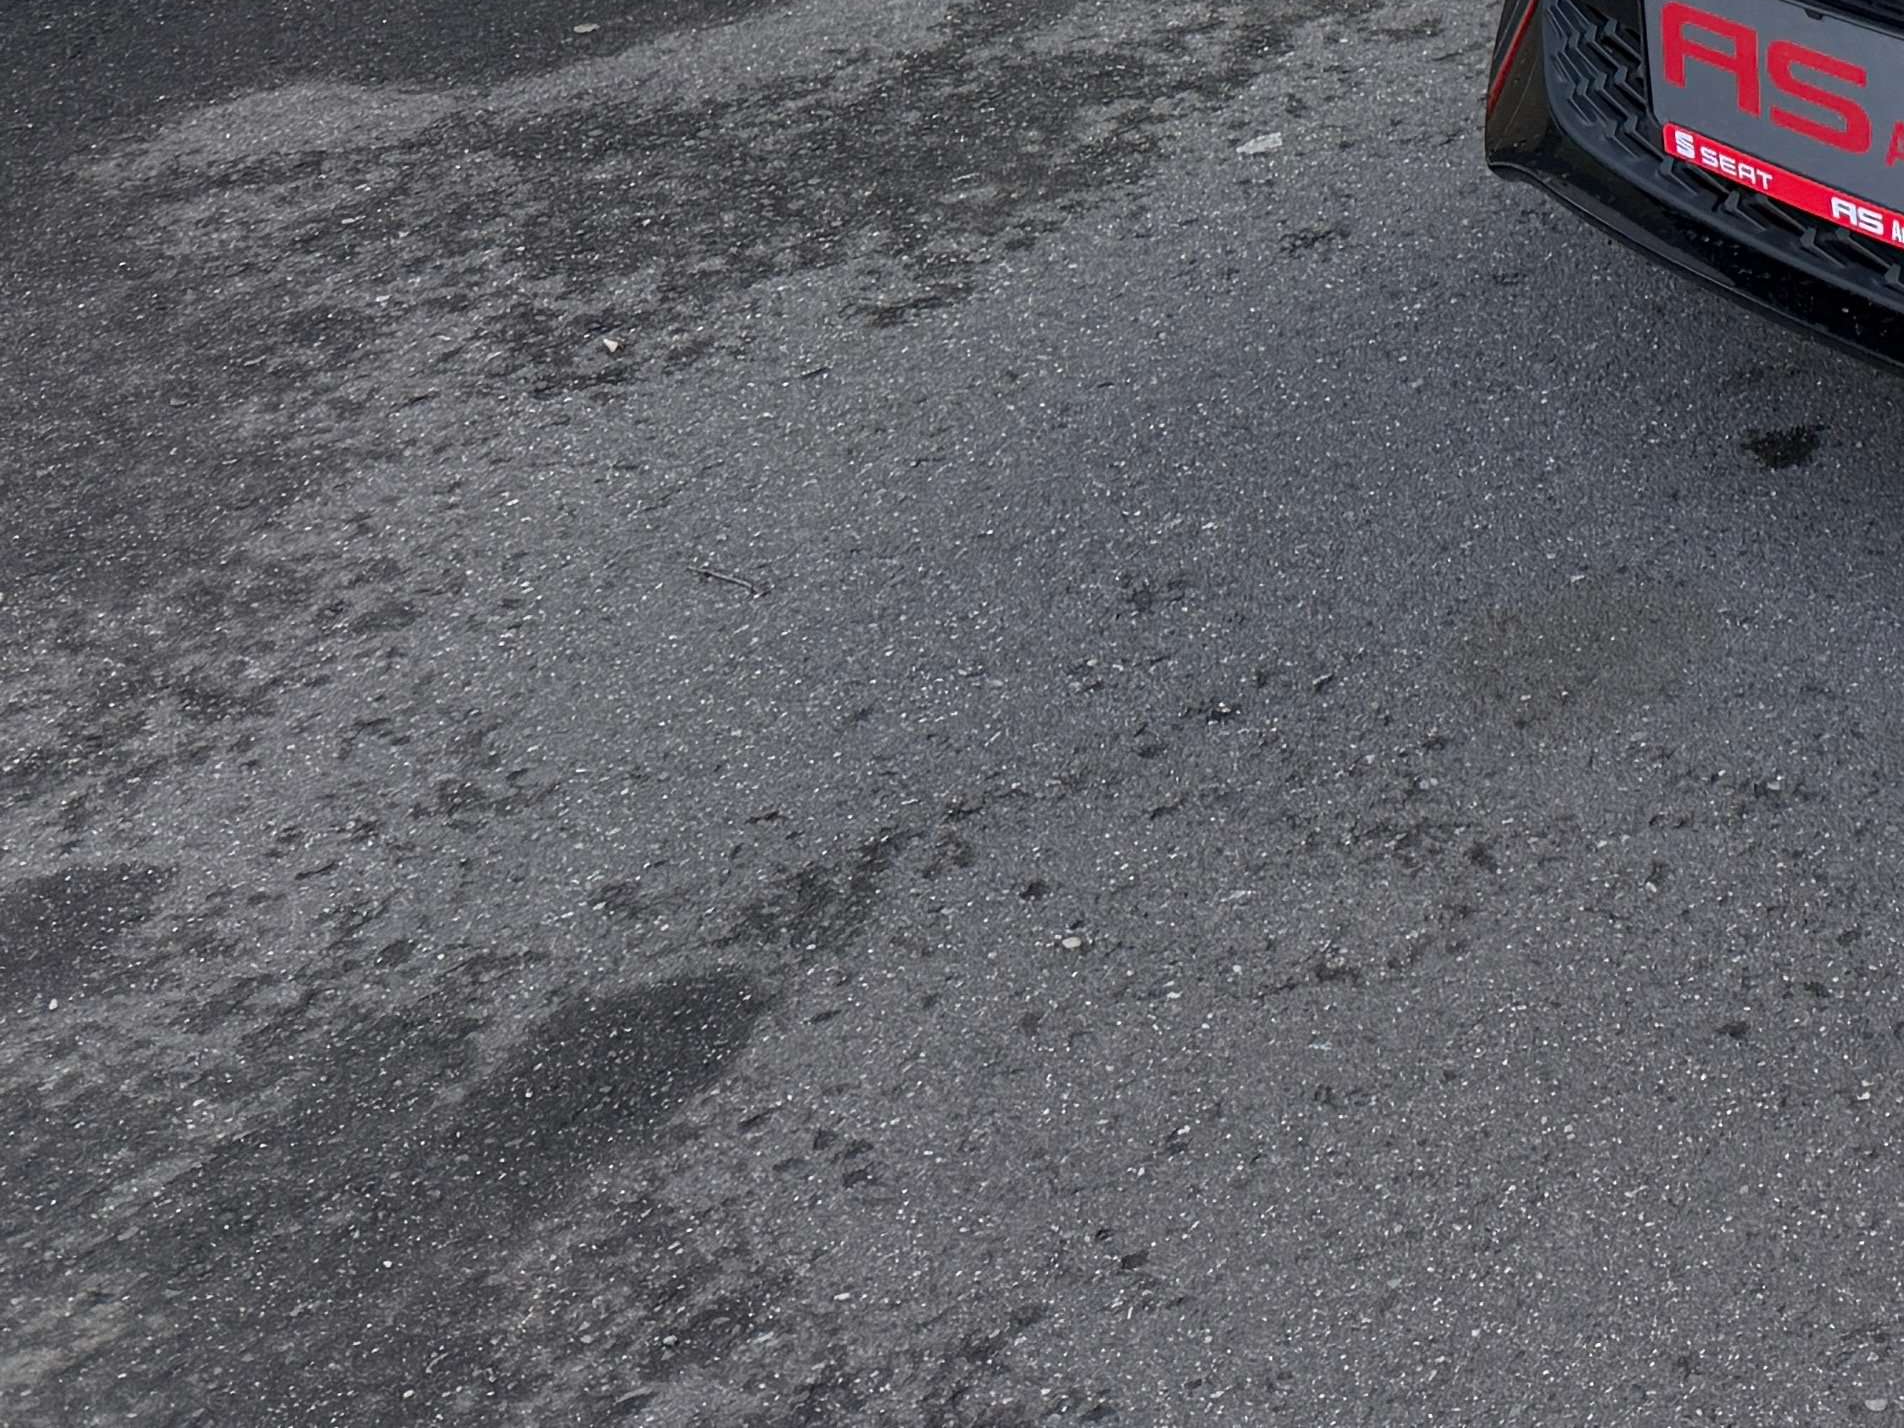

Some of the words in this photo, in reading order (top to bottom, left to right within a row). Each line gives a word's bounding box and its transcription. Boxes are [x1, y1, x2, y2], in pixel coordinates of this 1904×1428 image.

[1661, 0, 1873, 155] AS
[1700, 146, 1773, 191] SEAT
[1830, 197, 1885, 236] AS
